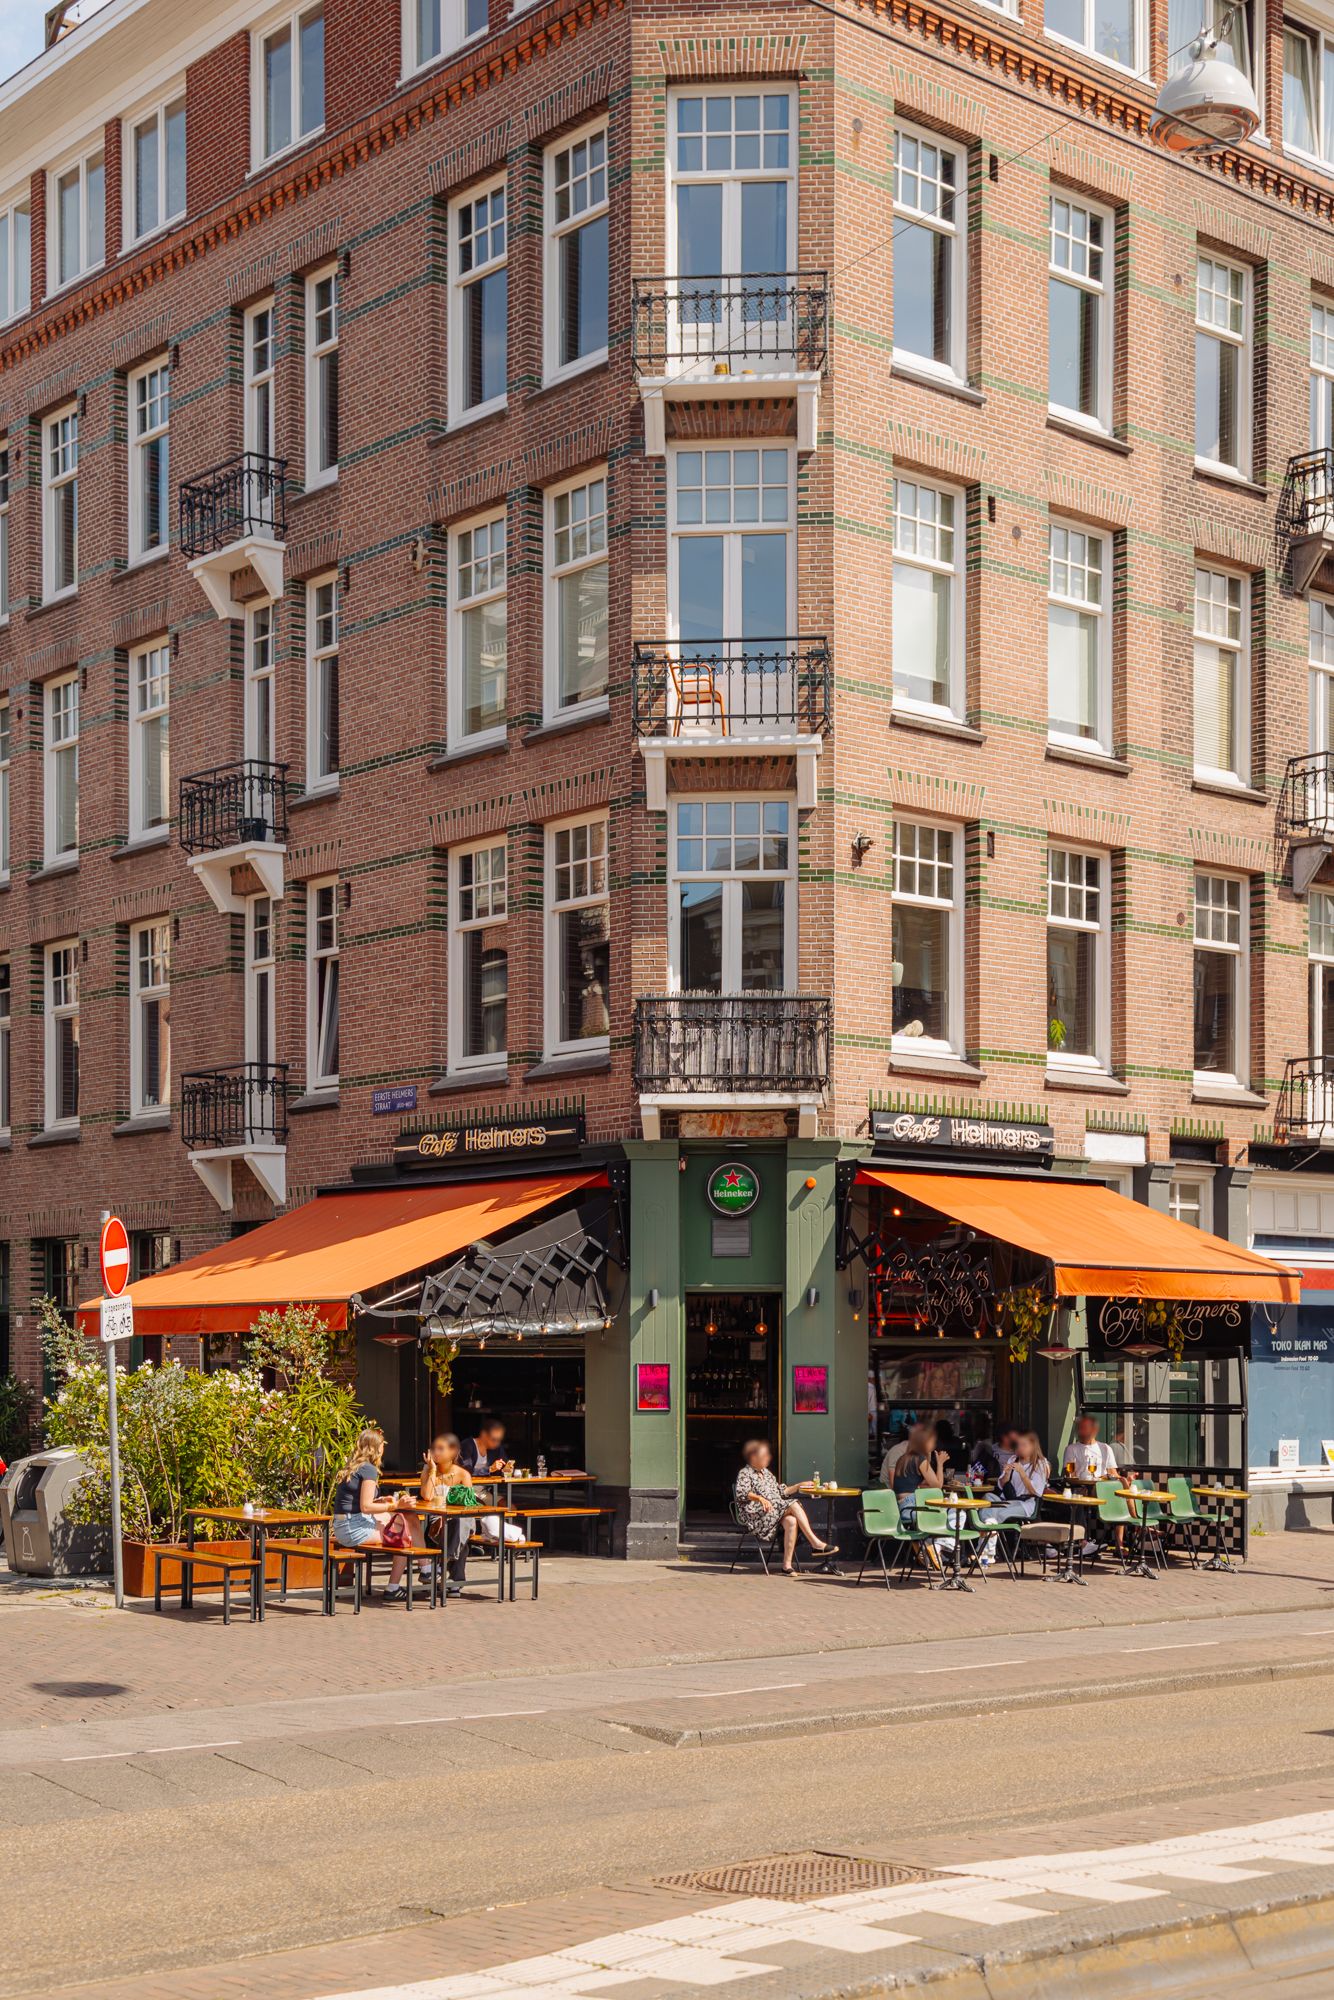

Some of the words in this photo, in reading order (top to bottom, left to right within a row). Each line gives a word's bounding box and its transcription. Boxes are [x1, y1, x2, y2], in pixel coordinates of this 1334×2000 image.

[374, 1091, 391, 1102] EERSTE
[391, 1088, 414, 1100] HELMERS
[374, 1101, 391, 1111] STRAAT
[893, 1114, 941, 1141] Café
[951, 1118, 1041, 1149] Helmers
[465, 1126, 547, 1152] Helmers
[713, 1189, 753, 1198] Heineken
[1099, 1297, 1145, 1347] Caf
[1173, 1301, 1242, 1341] elmers
[1271, 1340, 1292, 1351] TOKO
[1294, 1340, 1311, 1351] IKAN
[1313, 1340, 1328, 1351] MAS
